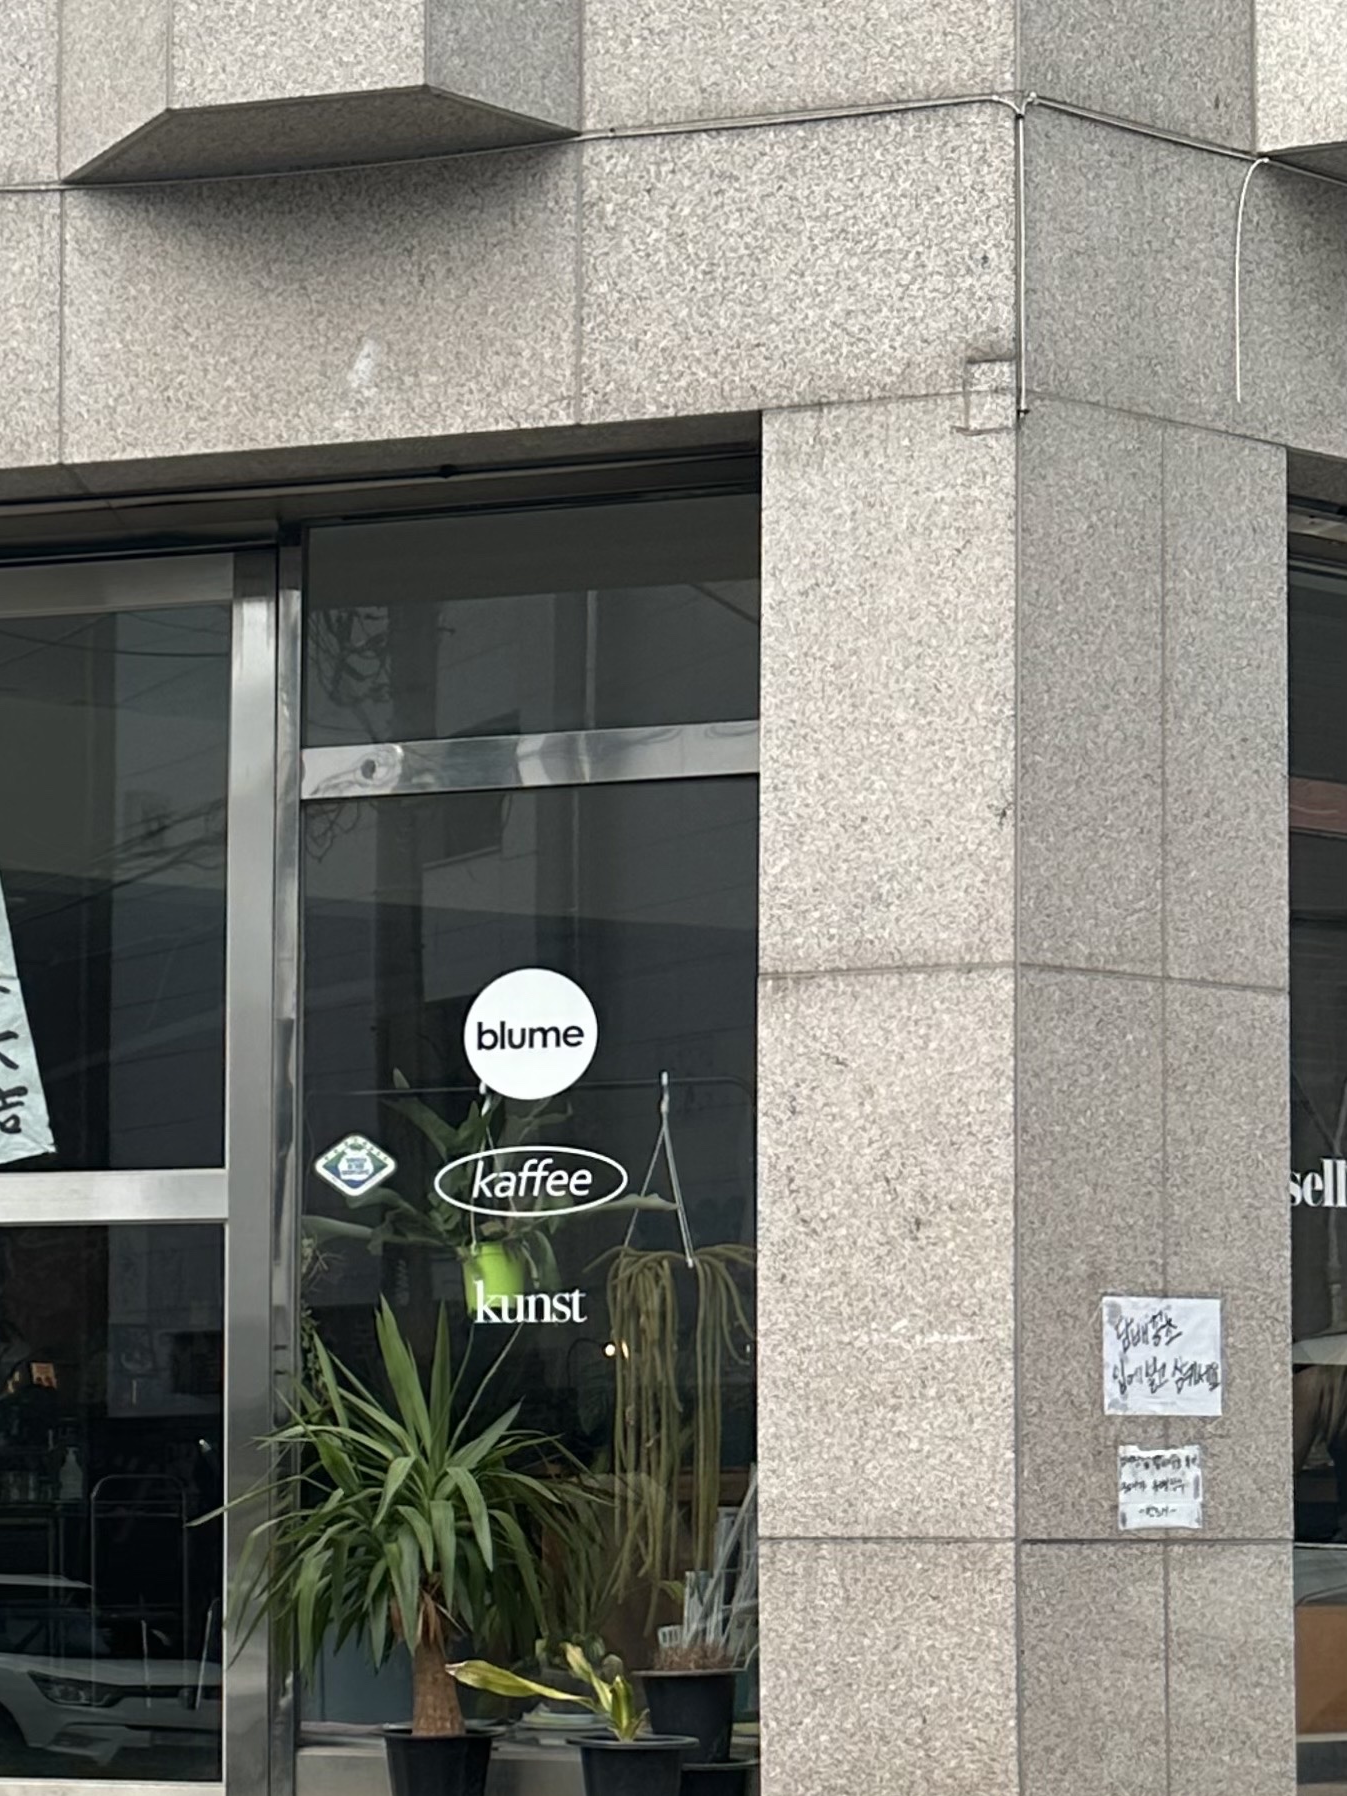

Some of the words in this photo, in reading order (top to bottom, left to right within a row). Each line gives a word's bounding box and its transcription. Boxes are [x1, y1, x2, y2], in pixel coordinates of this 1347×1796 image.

[475, 1020, 586, 1052] blume
[471, 1157, 594, 1199] kaffee
[473, 1279, 588, 1325] kunst
